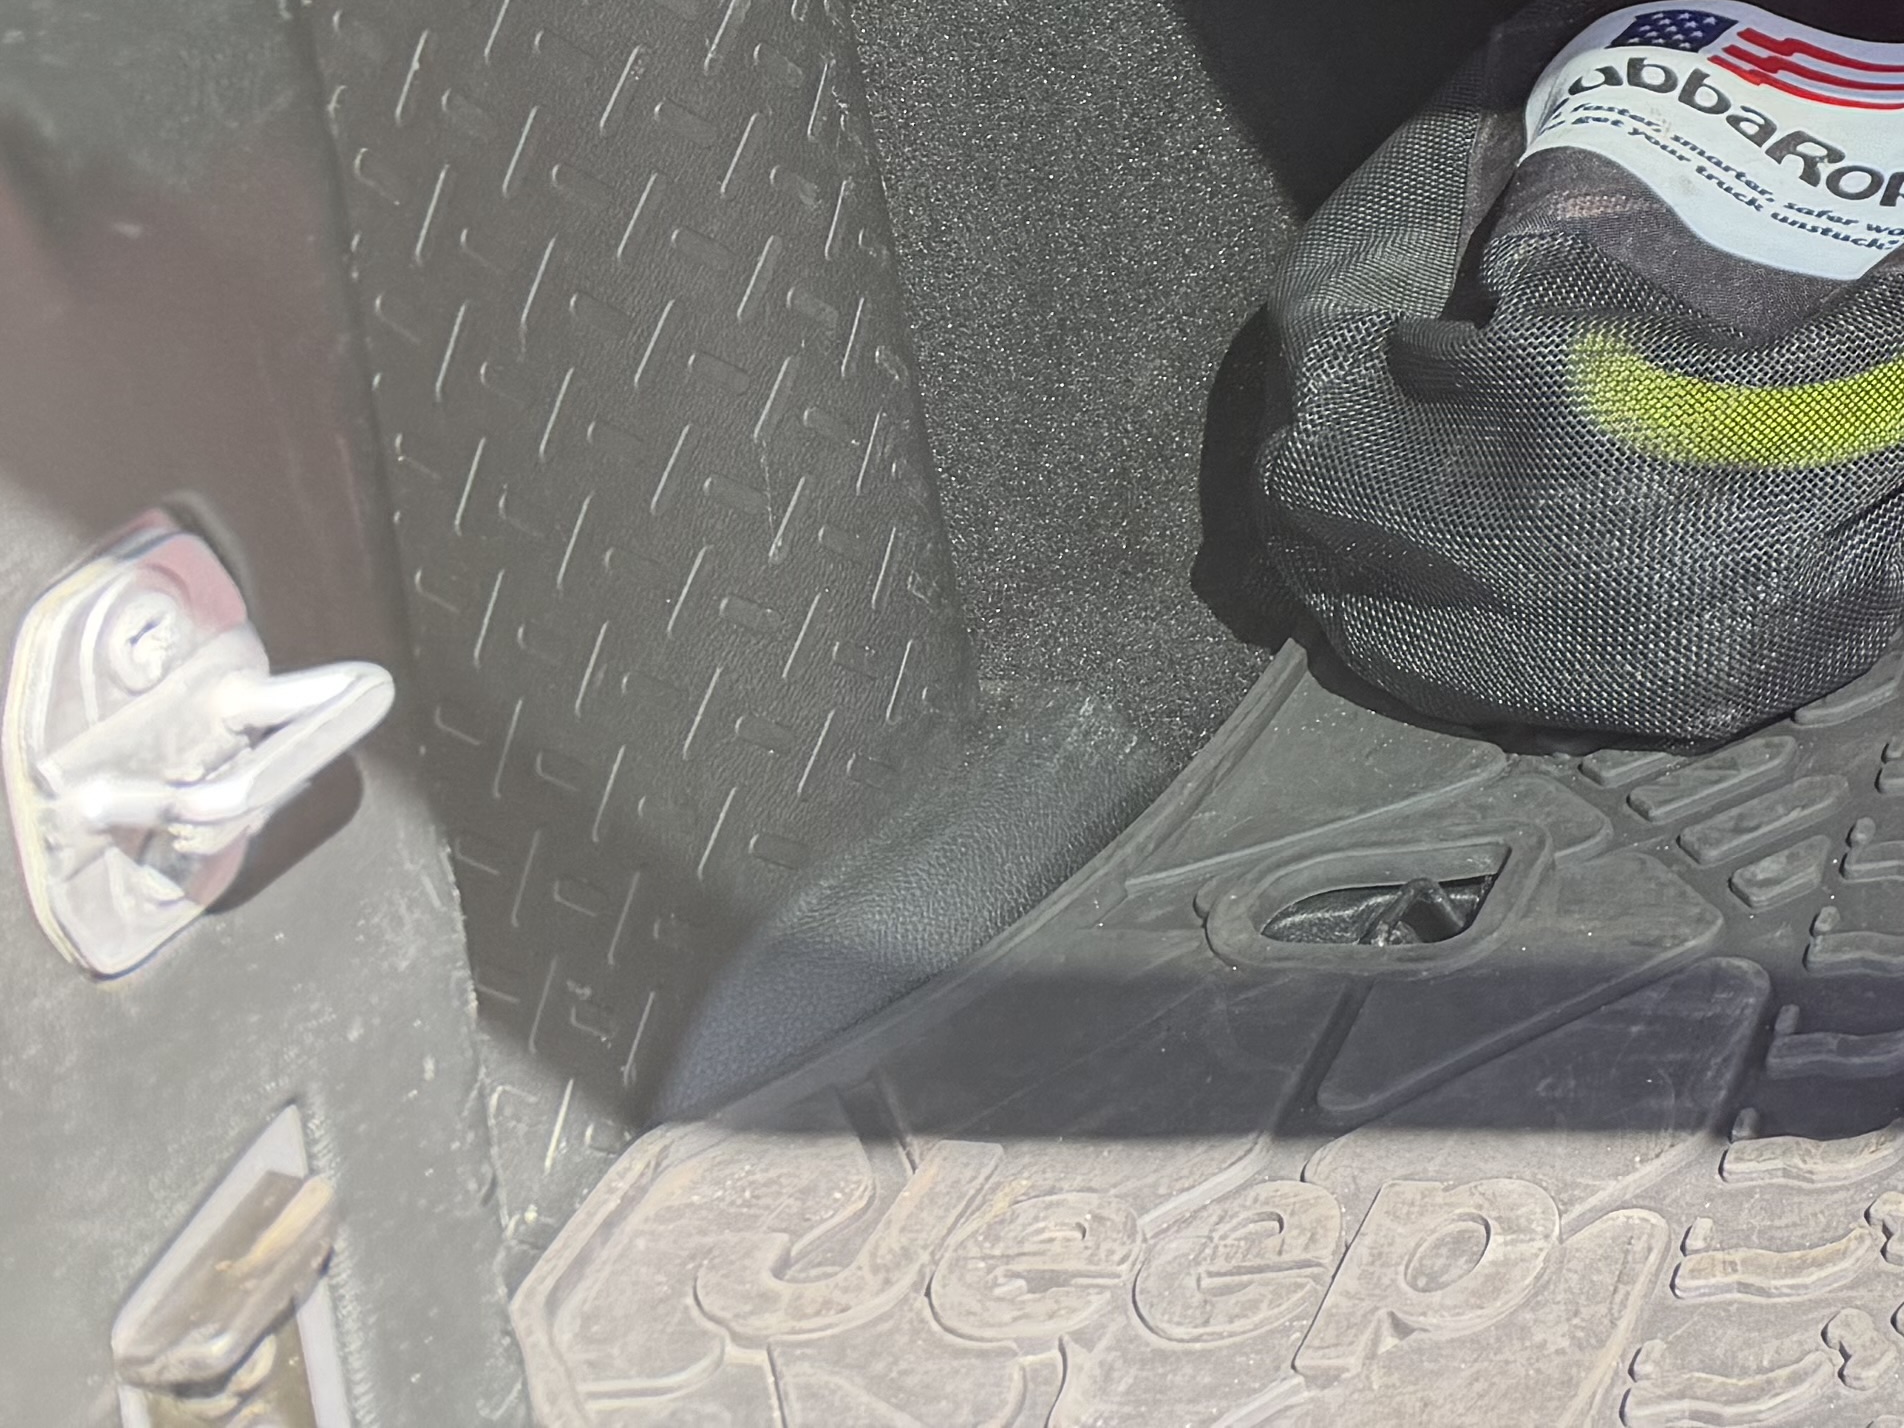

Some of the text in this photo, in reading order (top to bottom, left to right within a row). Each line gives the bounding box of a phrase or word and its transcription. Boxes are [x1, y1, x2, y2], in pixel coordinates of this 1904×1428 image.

[1572, 116, 1624, 127] get
[1628, 127, 1692, 162] your
[1695, 165, 1764, 212] truck
[1784, 202, 1859, 226] safer
[694, 1140, 1562, 1375] Jeep
